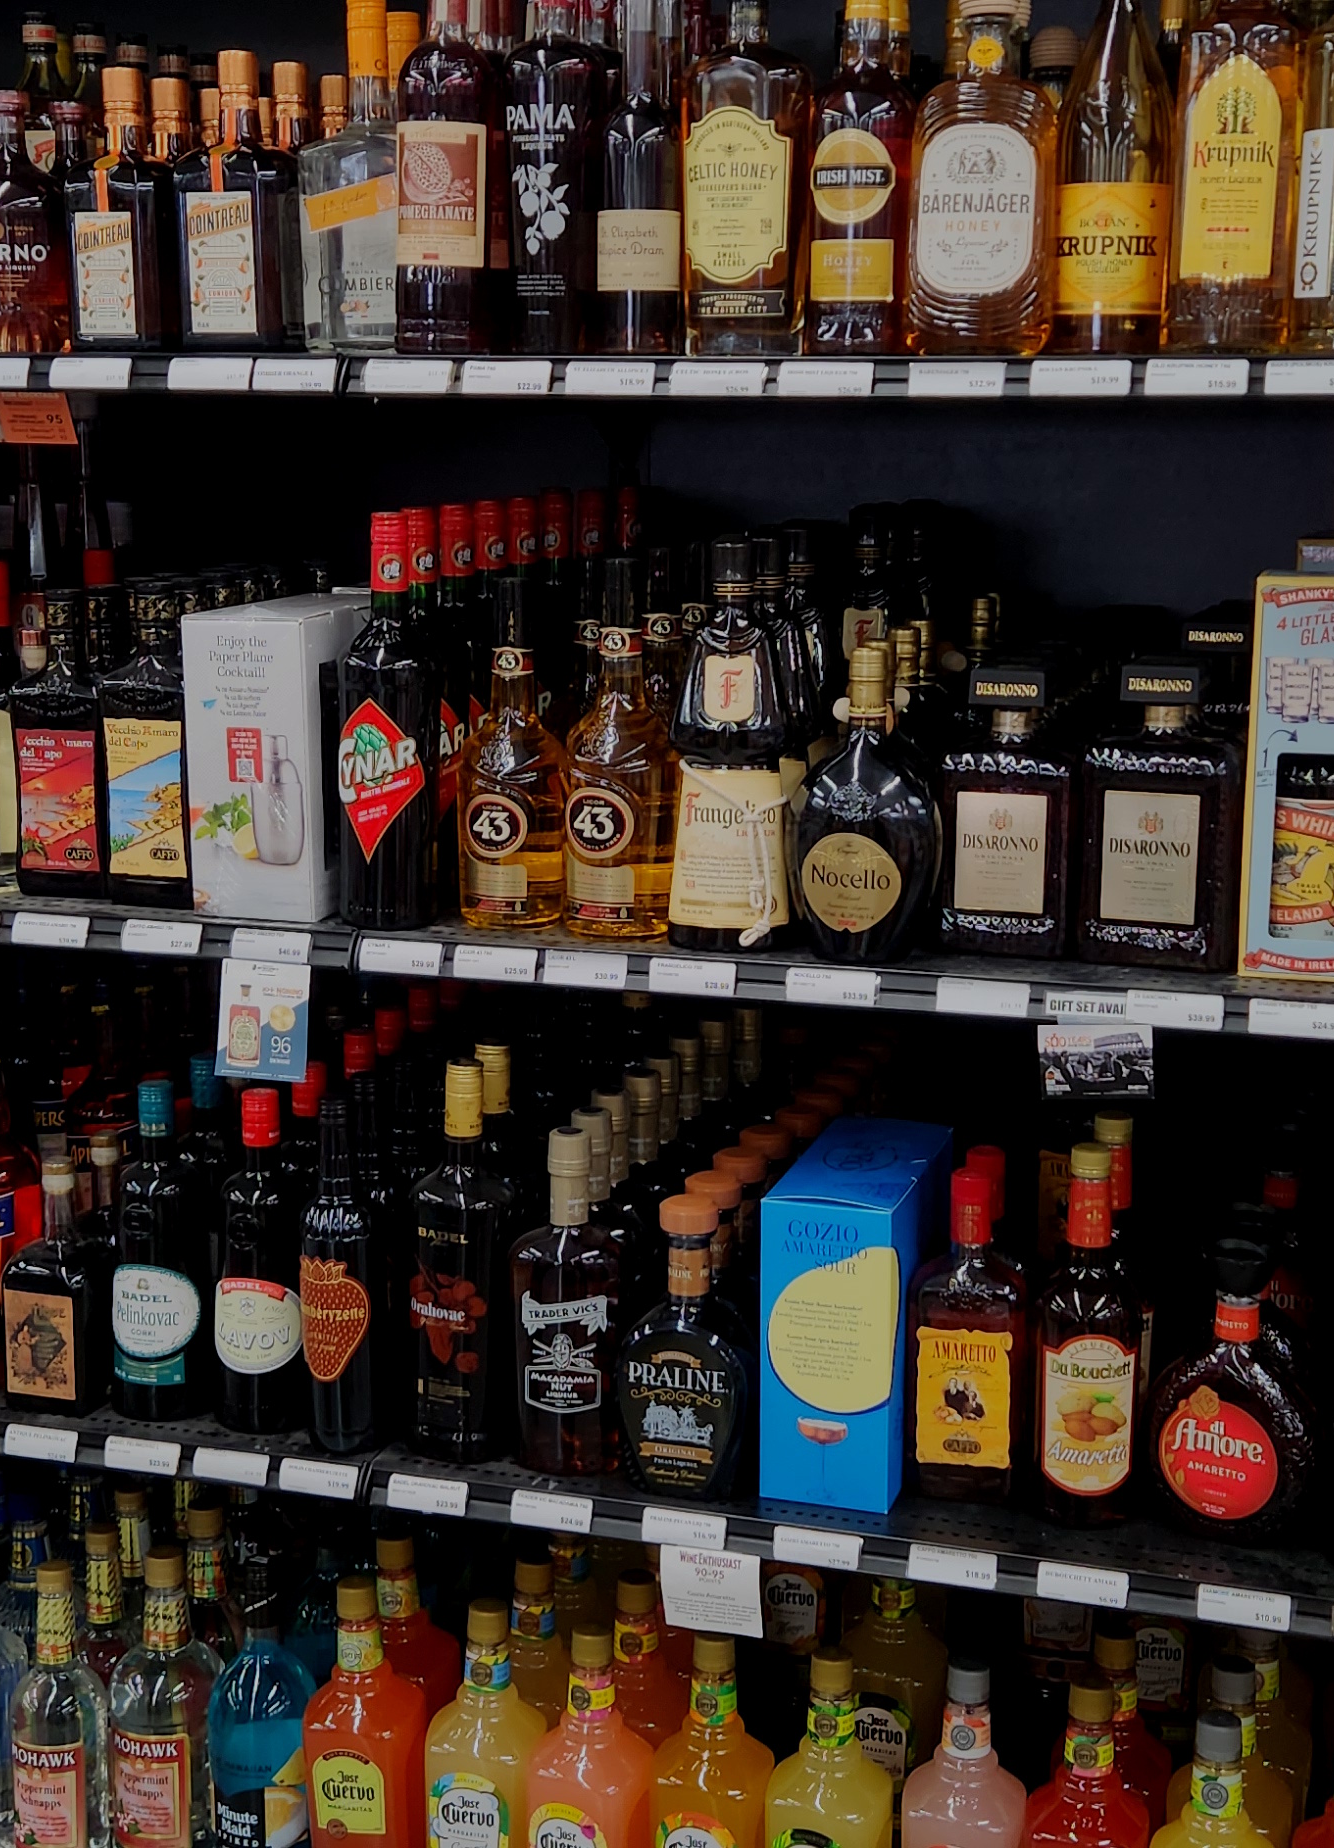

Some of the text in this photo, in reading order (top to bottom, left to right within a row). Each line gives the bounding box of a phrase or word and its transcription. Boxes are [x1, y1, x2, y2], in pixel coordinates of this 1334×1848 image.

[506, 104, 574, 131] PAMA
[1194, 140, 1273, 169] Krupnik
[689, 161, 778, 183] CELTIC HONEY
[817, 169, 883, 185] IRISH MIST
[922, 189, 1030, 214] BÄRENJÄGER
[1302, 150, 1321, 256] KRUPNIK
[189, 205, 250, 236] COINTREAU
[946, 220, 1001, 231] HONEY
[78, 223, 130, 251] COINTREAU
[611, 227, 658, 239] Elizabeth
[631, 243, 664, 256] Dram
[1056, 236, 1156, 257] KRUPNIK
[517, 382, 542, 391] $22.99
[1277, 618, 1287, 629] 4
[217, 635, 267, 649] Enjoy the
[209, 651, 274, 664] Paper Plane
[217, 665, 266, 678] Cocktail!
[975, 681, 1039, 697] DISARONNO
[106, 722, 178, 737] Vecchio Amaro
[108, 737, 148, 749] del Capo
[338, 736, 417, 803] CYNAR
[472, 811, 512, 839] 43
[573, 806, 615, 838] 43
[963, 833, 1038, 852] DISARONNO
[1109, 837, 1190, 857] DISARONNO
[65, 848, 94, 860] CAFFO
[151, 848, 179, 860] CAFFO
[811, 862, 890, 890] Nocello
[1050, 1000, 1094, 1012] GIFT SET
[271, 1036, 291, 1054] 96
[788, 1219, 859, 1244] GOZIO
[781, 1241, 867, 1261] AMARETTO
[815, 1258, 857, 1275] SOUR
[122, 1290, 172, 1304] BADEL
[117, 1303, 180, 1330] Pelinkovac
[411, 1298, 466, 1322] Orahovac
[528, 1301, 598, 1319] TRADER VIC'S
[218, 1321, 291, 1350] LAVOV
[932, 1339, 997, 1362] AMARETTO
[531, 1372, 595, 1384] MACADAMIA
[628, 1361, 725, 1393] PRALINE
[1050, 1359, 1131, 1380] Du Bouchett
[551, 1382, 573, 1391] NUT
[1170, 1418, 1262, 1462] Amore
[655, 1445, 696, 1457] ORIGINAL
[1047, 1439, 1129, 1468] Amaretto
[1187, 1460, 1247, 1482] AMARETTO
[699, 1553, 741, 1570] ENTHUSIAST
[695, 1568, 724, 1579] 90-95
[12, 1746, 76, 1766] MOHAWK
[114, 1736, 177, 1757] MOHAWK
[338, 1771, 359, 1784] Jose
[322, 1779, 375, 1802] Cuervo
[458, 1796, 479, 1809] Jose
[218, 1802, 257, 1825] Minute
[442, 1805, 494, 1827] Cuervo
